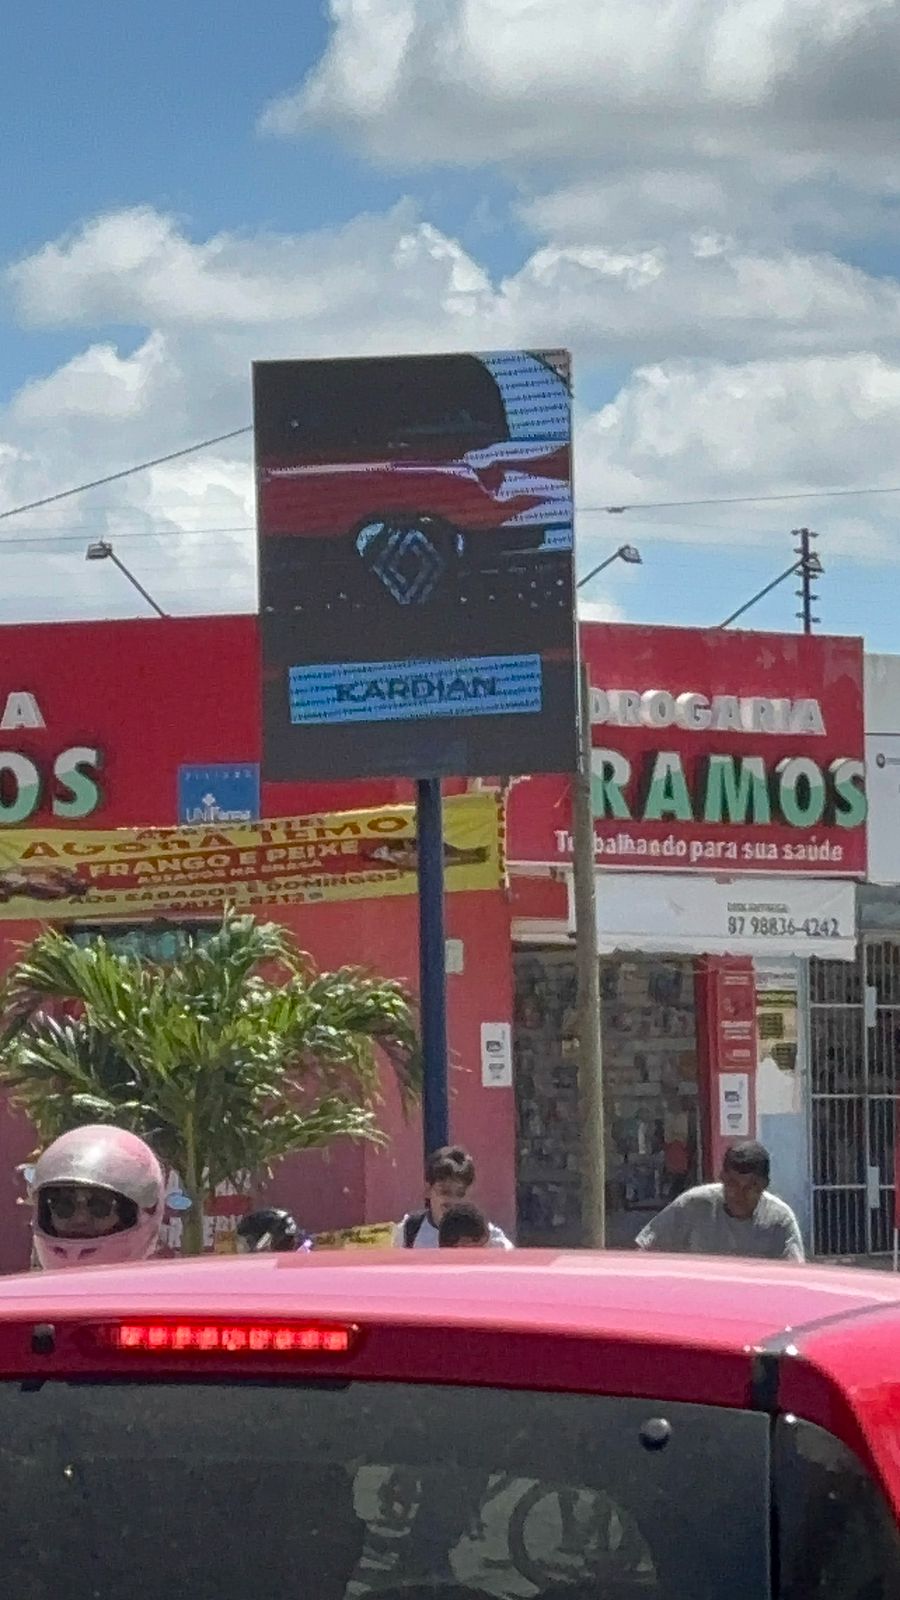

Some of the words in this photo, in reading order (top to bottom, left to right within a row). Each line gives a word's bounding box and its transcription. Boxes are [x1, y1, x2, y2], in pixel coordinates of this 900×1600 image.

[336, 675, 498, 702] KARDIAN
[590, 687, 827, 736] DROGARIA
[591, 747, 868, 828] RAMOS
[20, 830, 237, 859] AGORA
[260, 816, 409, 843] TEMO
[554, 829, 686, 857] Trbalhando
[690, 838, 737, 862] para
[742, 841, 779, 860] sua
[782, 835, 843, 862] saúde
[89, 853, 231, 878] FRANGO
[239, 851, 257, 867] E
[266, 840, 359, 863] PEIXE
[69, 894, 117, 905] AOS
[728, 915, 745, 935] 87
